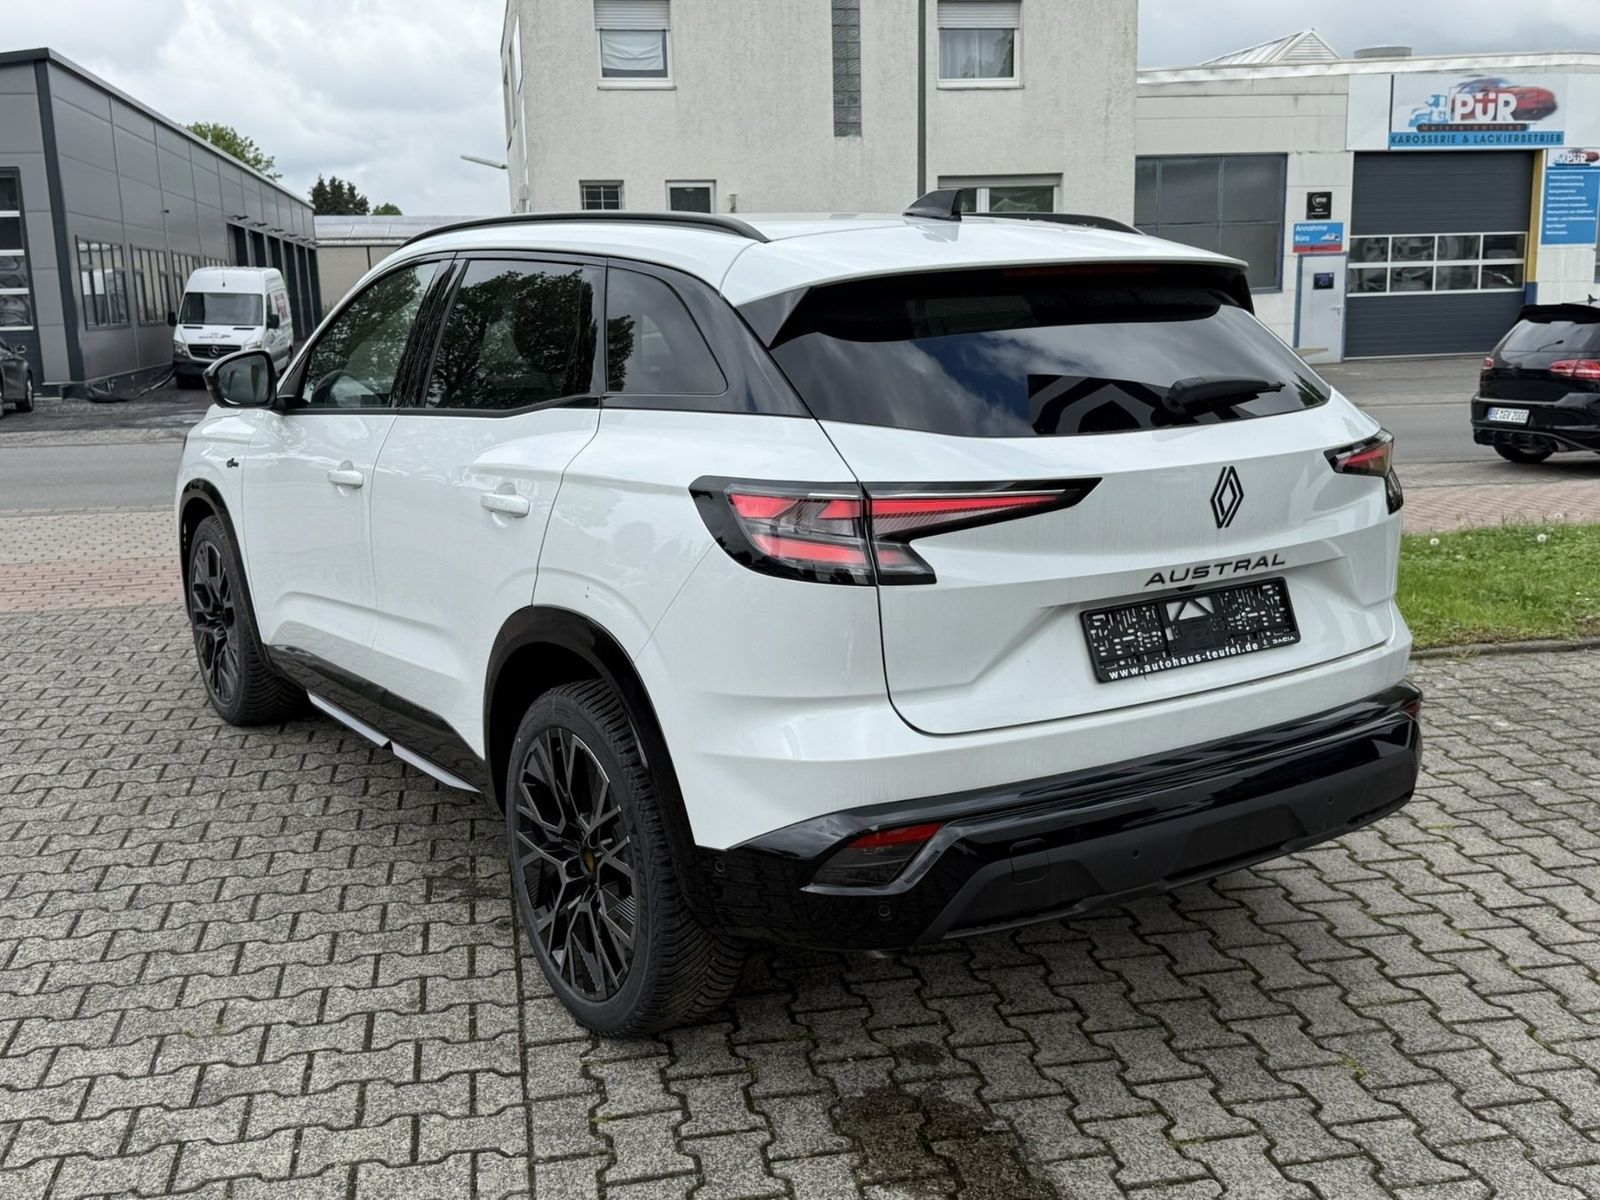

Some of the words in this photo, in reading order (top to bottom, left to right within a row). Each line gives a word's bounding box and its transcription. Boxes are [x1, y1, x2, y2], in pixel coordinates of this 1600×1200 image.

[1390, 134, 1456, 144] KAROSSERIE
[1462, 134, 1469, 144] &
[1474, 133, 1562, 144] LACKIERBETRIEB
[1144, 554, 1286, 587] AUSTRAL
[1109, 641, 1259, 680] www.autohaus-teufel.de
[1272, 636, 1296, 645] DACIA
